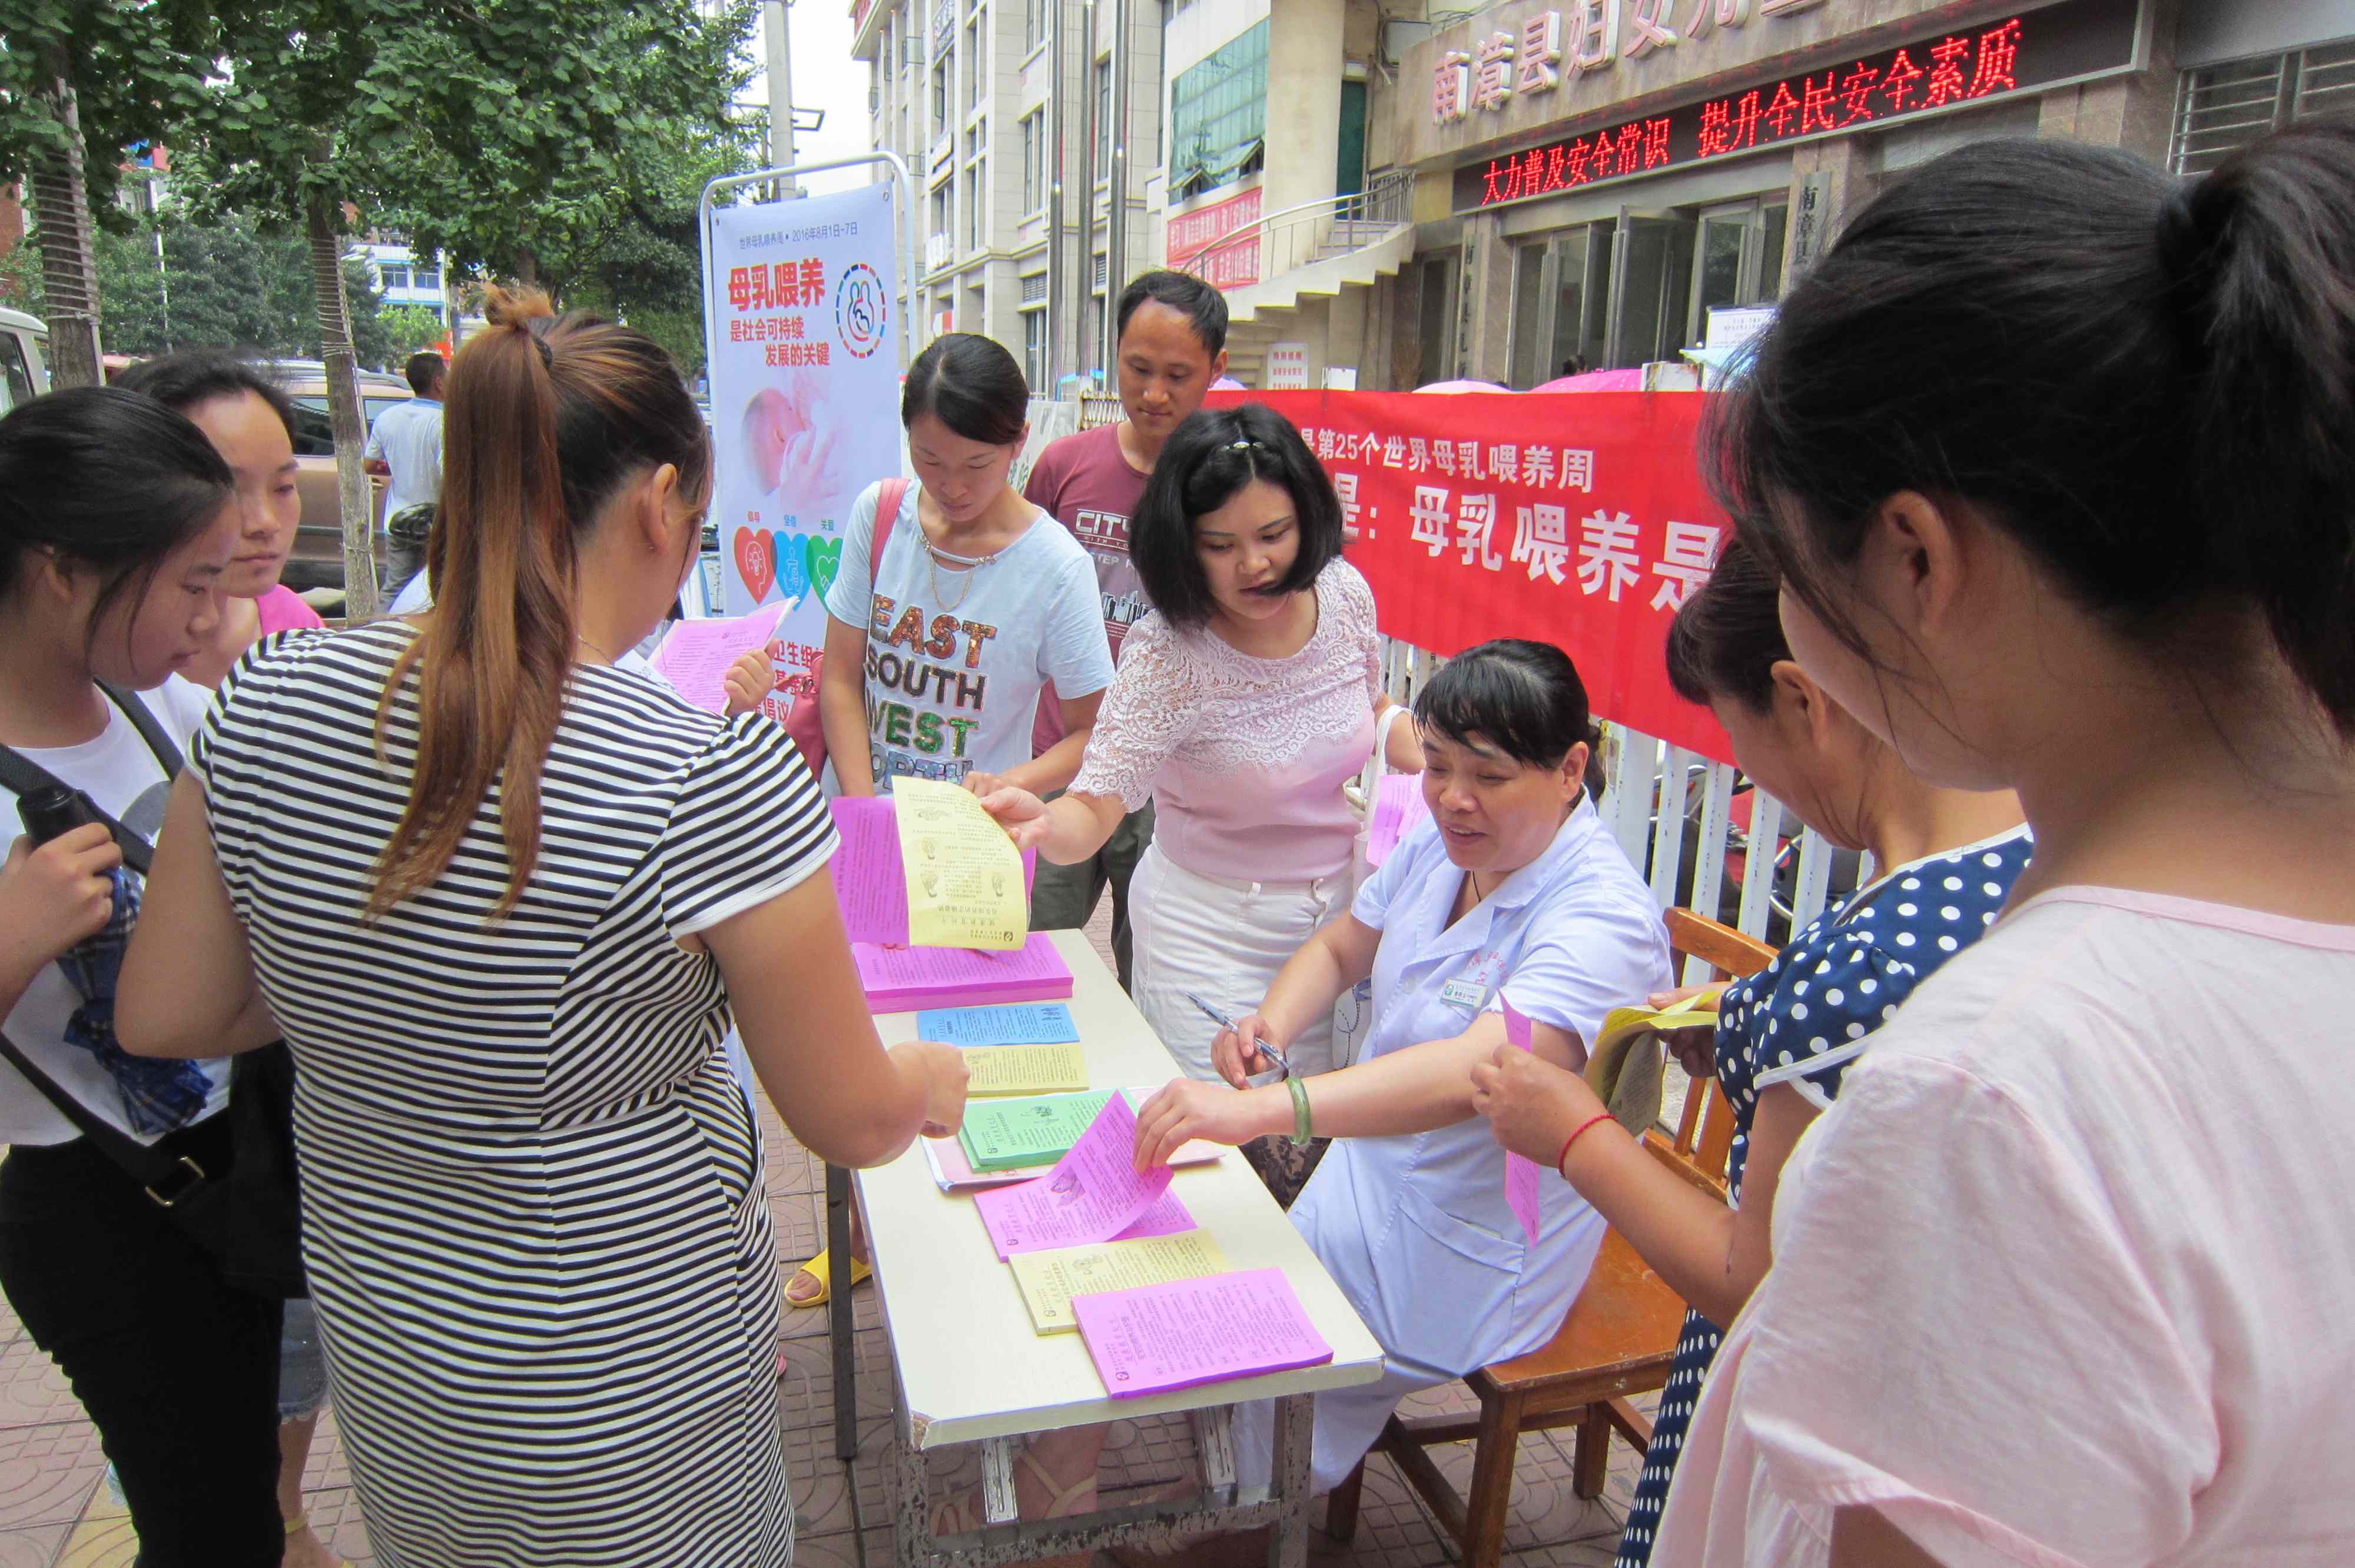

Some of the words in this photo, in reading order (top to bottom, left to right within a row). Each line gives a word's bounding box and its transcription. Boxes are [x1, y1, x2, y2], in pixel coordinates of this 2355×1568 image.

[1432, 0, 1820, 125] 南漳县妇女
[1481, 118, 1671, 205] 大力普及安全常识
[1698, 19, 2022, 158] 提升全民安全素质
[792, 221, 858, 242] 2016年8月1日-7日
[728, 258, 826, 312] 母乳喂养
[730, 317, 805, 343] 是社会可持续
[765, 341, 830, 367] 发展的关键
[1301, 427, 1594, 493] 是第25个世界母乳喂养周
[1092, 553, 1119, 566] TEP
[772, 640, 817, 668] 卫生组
[870, 593, 997, 669] EAST
[864, 643, 989, 711] SOUTH
[756, 697, 790, 722] 倡议
[865, 687, 980, 759] WEST
